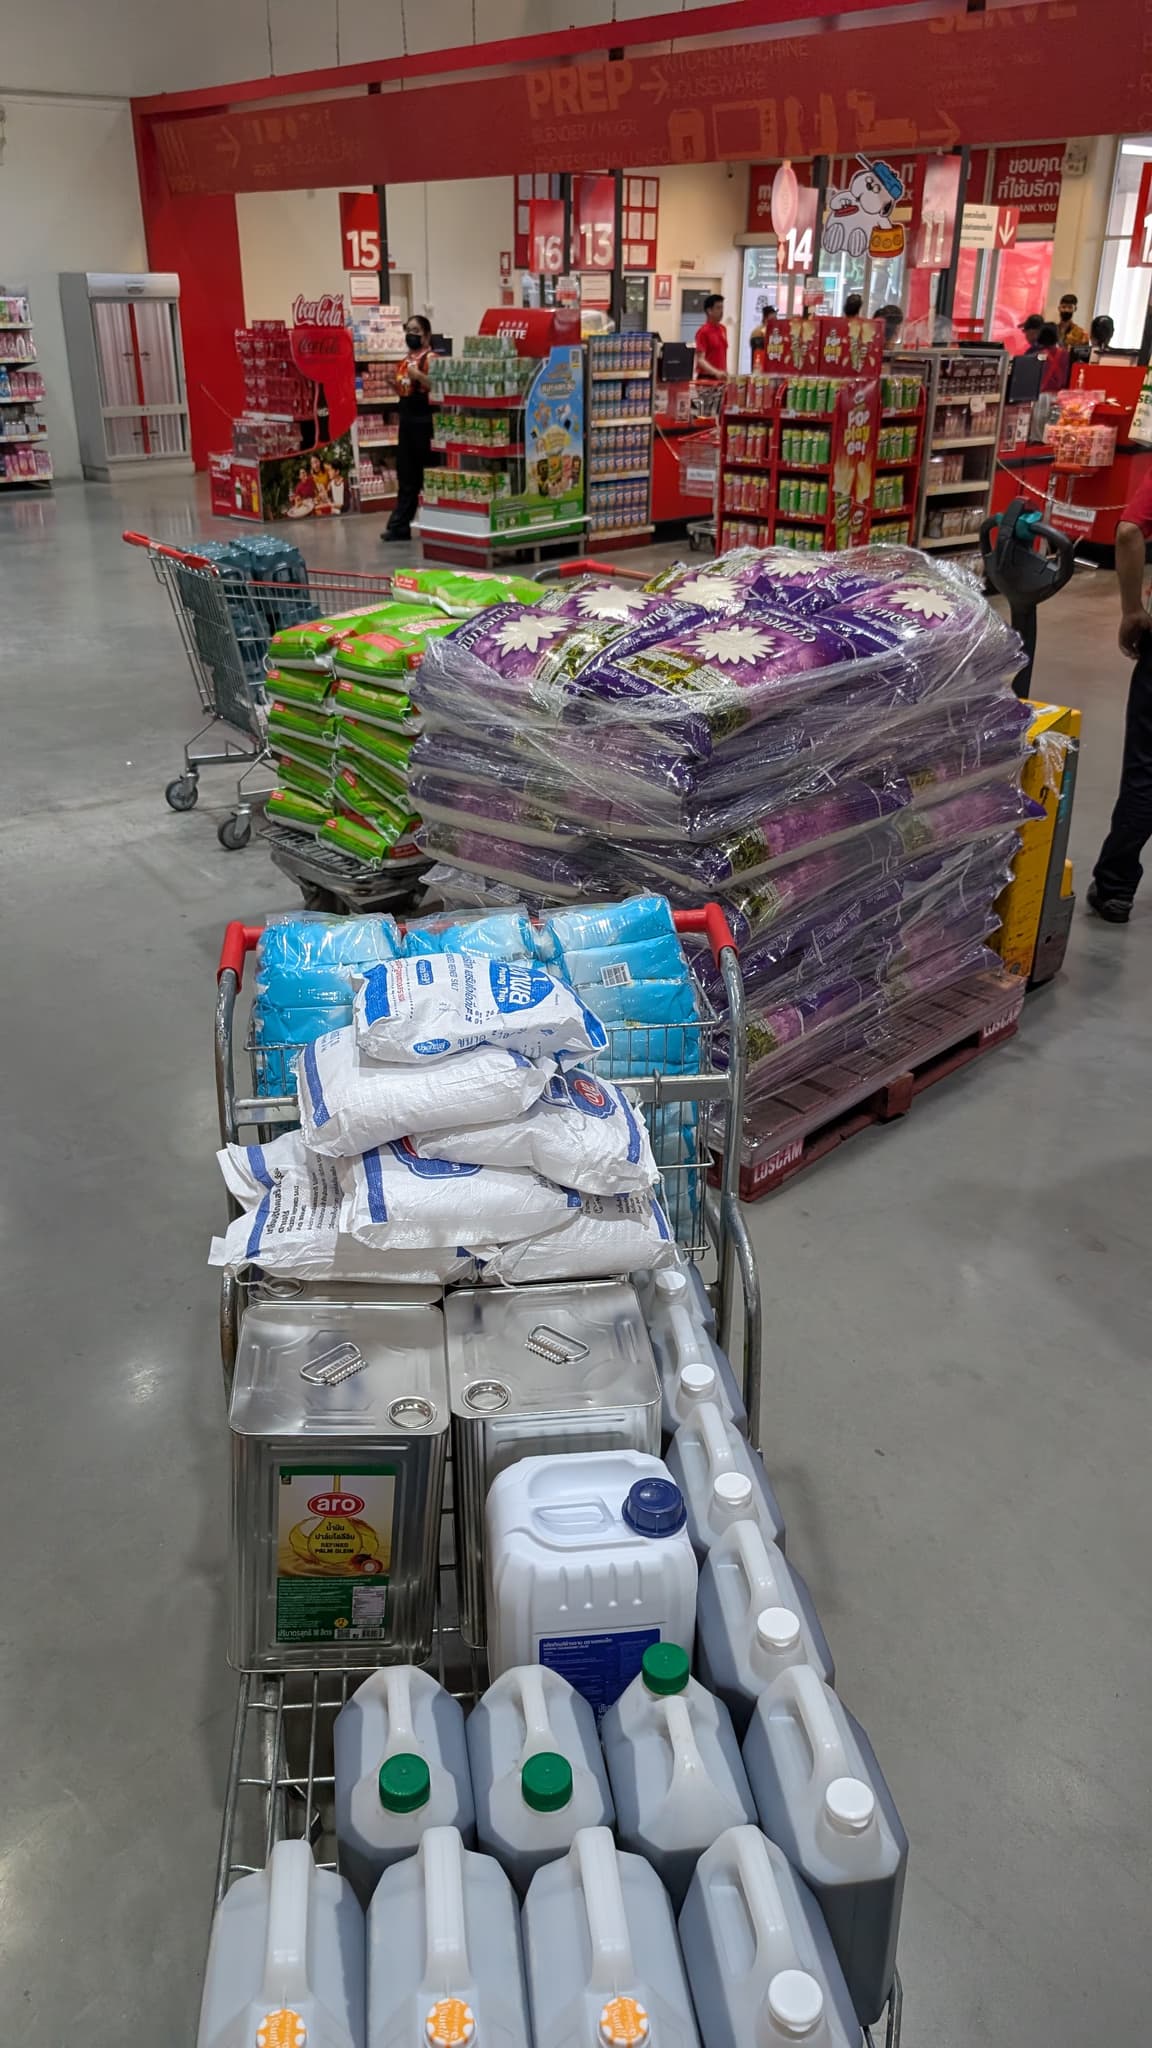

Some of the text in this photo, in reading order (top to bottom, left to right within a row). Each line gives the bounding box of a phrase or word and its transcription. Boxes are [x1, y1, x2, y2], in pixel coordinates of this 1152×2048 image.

[526, 60, 634, 120] PREP
[346, 229, 381, 268] 15
[534, 235, 562, 271] 16
[580, 222, 613, 266] 13
[786, 226, 814, 271] 14
[497, 329, 527, 340] LOTTE
[848, 410, 870, 428] POP
[753, 1139, 805, 1184] LOSCAM
[316, 1499, 357, 1512] aro
